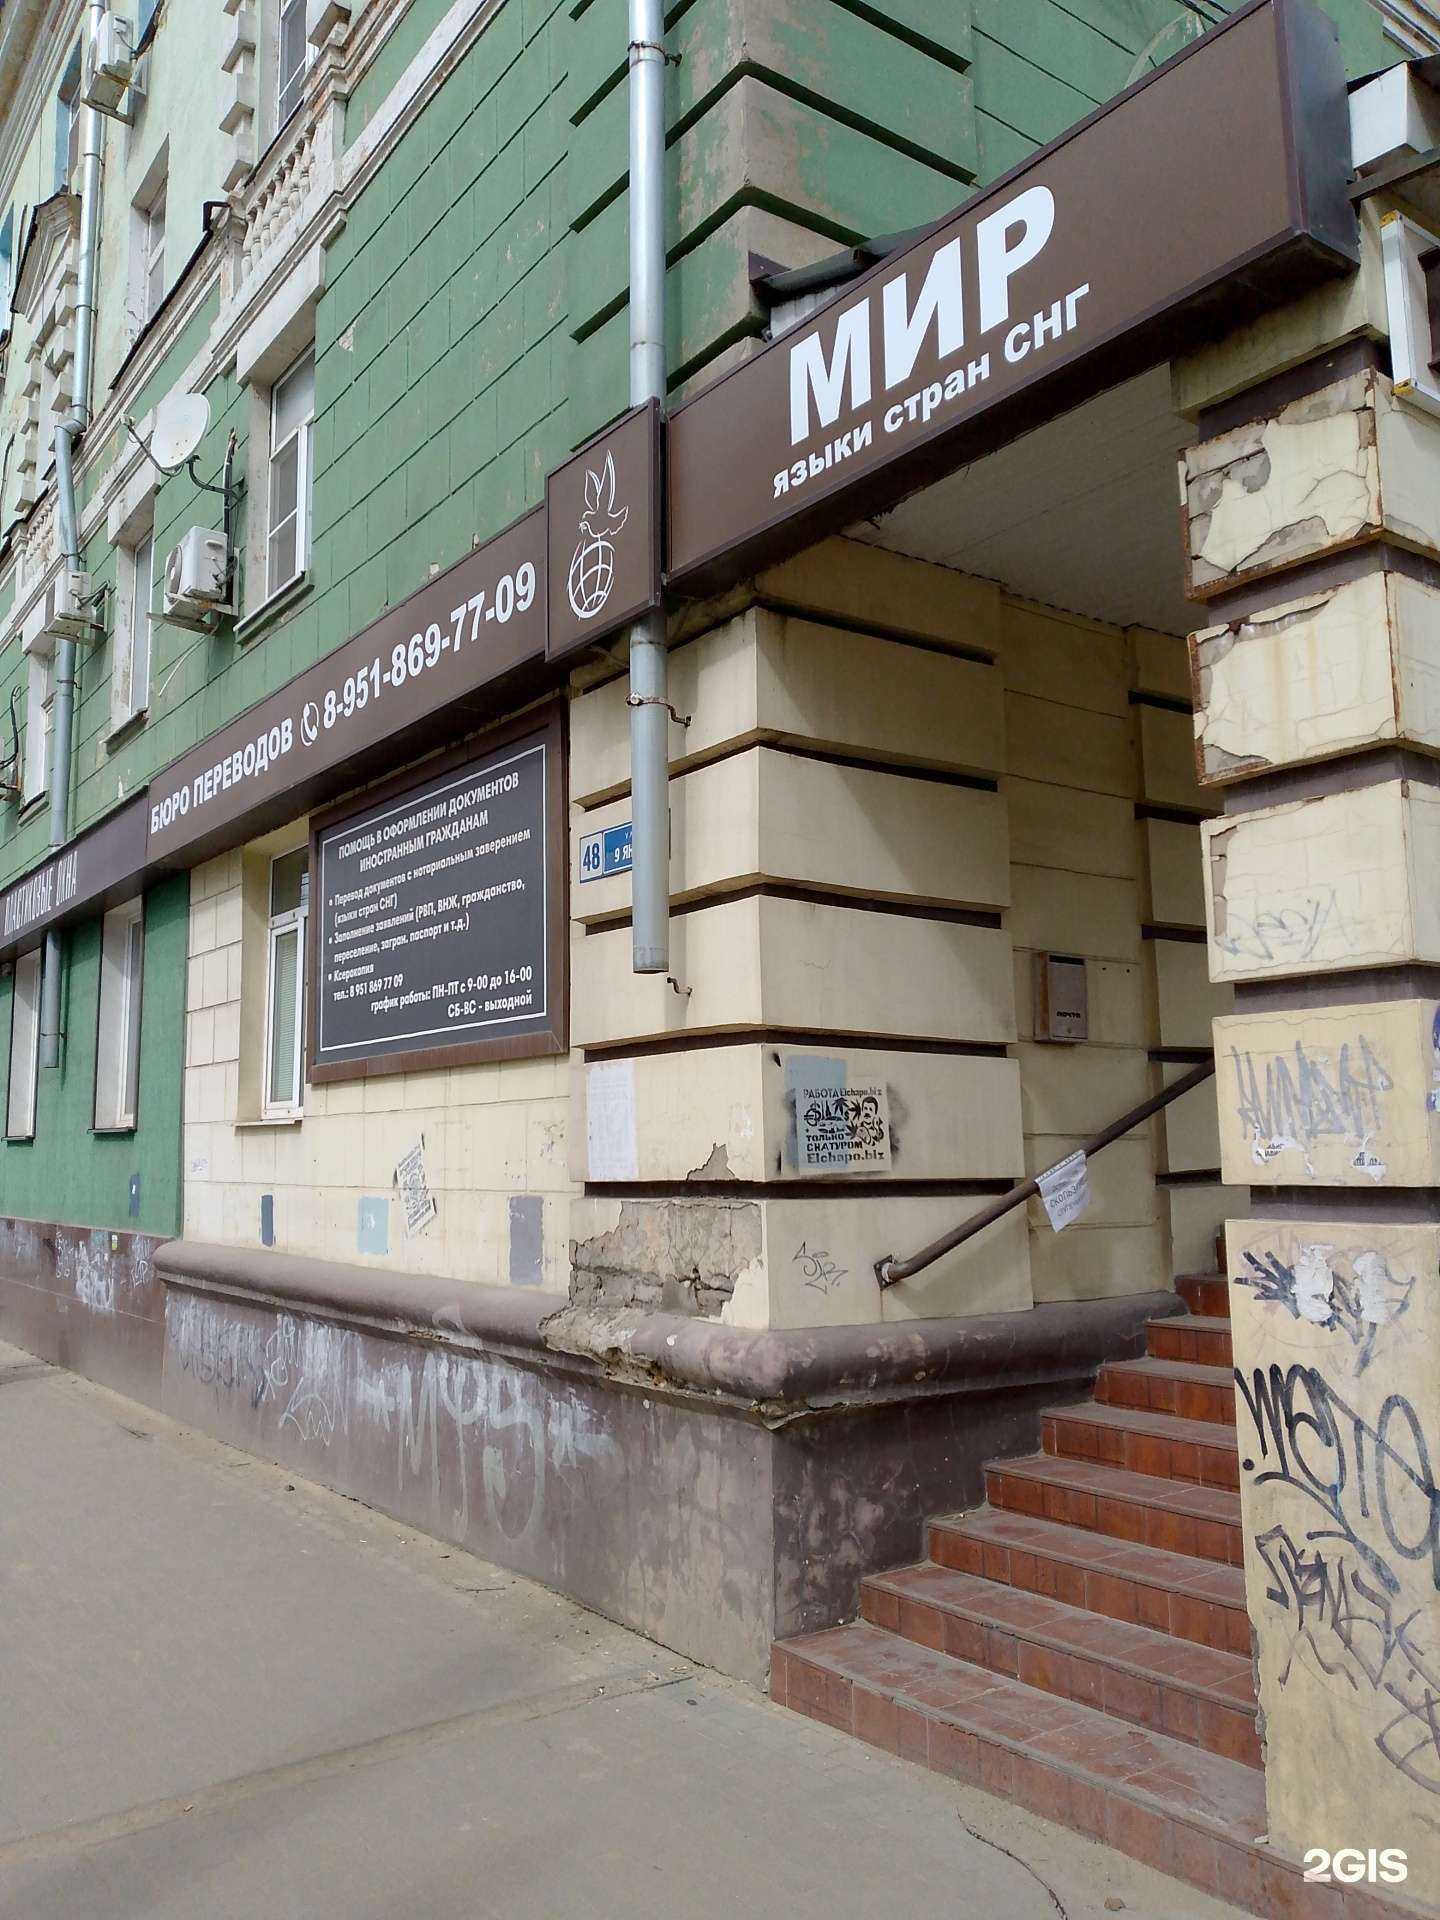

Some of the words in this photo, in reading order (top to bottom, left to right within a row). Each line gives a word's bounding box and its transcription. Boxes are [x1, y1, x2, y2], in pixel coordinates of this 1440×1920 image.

[790, 185, 1055, 446] МИР
[773, 421, 872, 499] языки
[884, 353, 990, 433] стран
[150, 786, 190, 834] БЮРО
[193, 718, 293, 807] ПЕРЕВОДОВ
[323, 561, 537, 729] 8-951-869-77-09
[338, 833, 376, 860] ПОМОЩЬ
[376, 830, 382, 844] В
[383, 802, 447, 841] ОФОРМЛЕНИИ
[448, 772, 519, 817] ДОКУМЕНТОВ
[360, 835, 425, 872] ИНОСТРАННЫМ
[425, 809, 489, 847] ГРАЖДАНАМ
[55, 851, 78, 907] ОКНА
[334, 889, 364, 907] Перевод
[364, 873, 406, 899] документов
[407, 871, 412, 881] с
[413, 848, 474, 880] нотариальным
[475, 829, 531, 854] заверением
[582, 842, 600, 872] 48
[614, 847, 620, 863] 9
[334, 924, 375, 944] Заполнение
[375, 908, 415, 932] заявлений
[415, 902, 437, 922] (РВП,
[437, 895, 460, 913] ВНЖ,
[461, 879, 525, 908] гражданство,
[358, 903, 379, 919] стран
[379, 893, 398, 910] СНГ)
[334, 942, 380, 965] переселение,
[380, 934, 409, 951] загран.
[409, 924, 443, 942] паспорт
[443, 922, 449, 932] и
[450, 912, 470, 932] т.д.)
[334, 964, 375, 982] Ксерокопия
[349, 985, 355, 997] 8
[355, 982, 368, 996] 951
[368, 978, 383, 994] 869
[383, 976, 393, 990] 77
[393, 973, 403, 988] 09
[370, 995, 399, 1014] график
[399, 990, 431, 1009] работы:
[432, 980, 460, 999] ПН-ПТ
[460, 983, 466, 993] с
[467, 974, 488, 992] 9-00
[489, 975, 502, 990] до
[504, 965, 533, 984] 16-00
[447, 1000, 477, 1018] СБ-ВС
[484, 988, 533, 1012] выходной
[803, 1087, 839, 1099] РАБОТА
[806, 1132, 845, 1142] ТОЛЬКО
